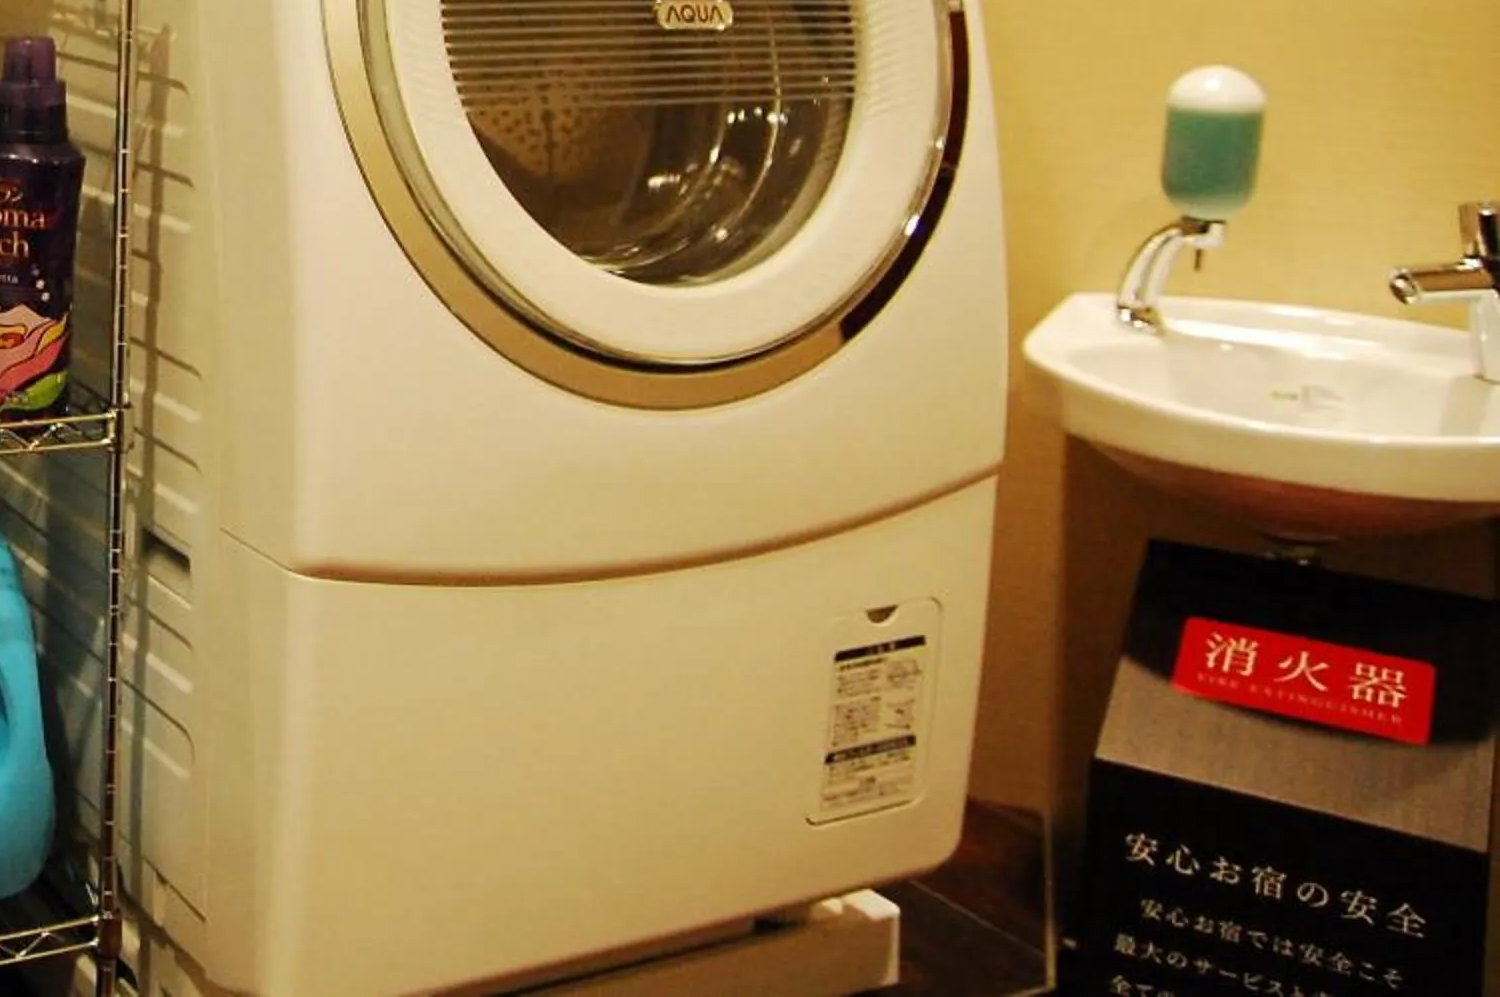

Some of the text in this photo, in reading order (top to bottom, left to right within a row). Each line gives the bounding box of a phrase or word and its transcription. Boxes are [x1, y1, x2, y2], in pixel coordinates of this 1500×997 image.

[666, 4, 724, 23] AQUA
[1203, 631, 1409, 709] 消火器
[1124, 832, 1427, 939] 安心お宿の安全
[1140, 897, 1404, 990] 安心お宿では安全こそ
